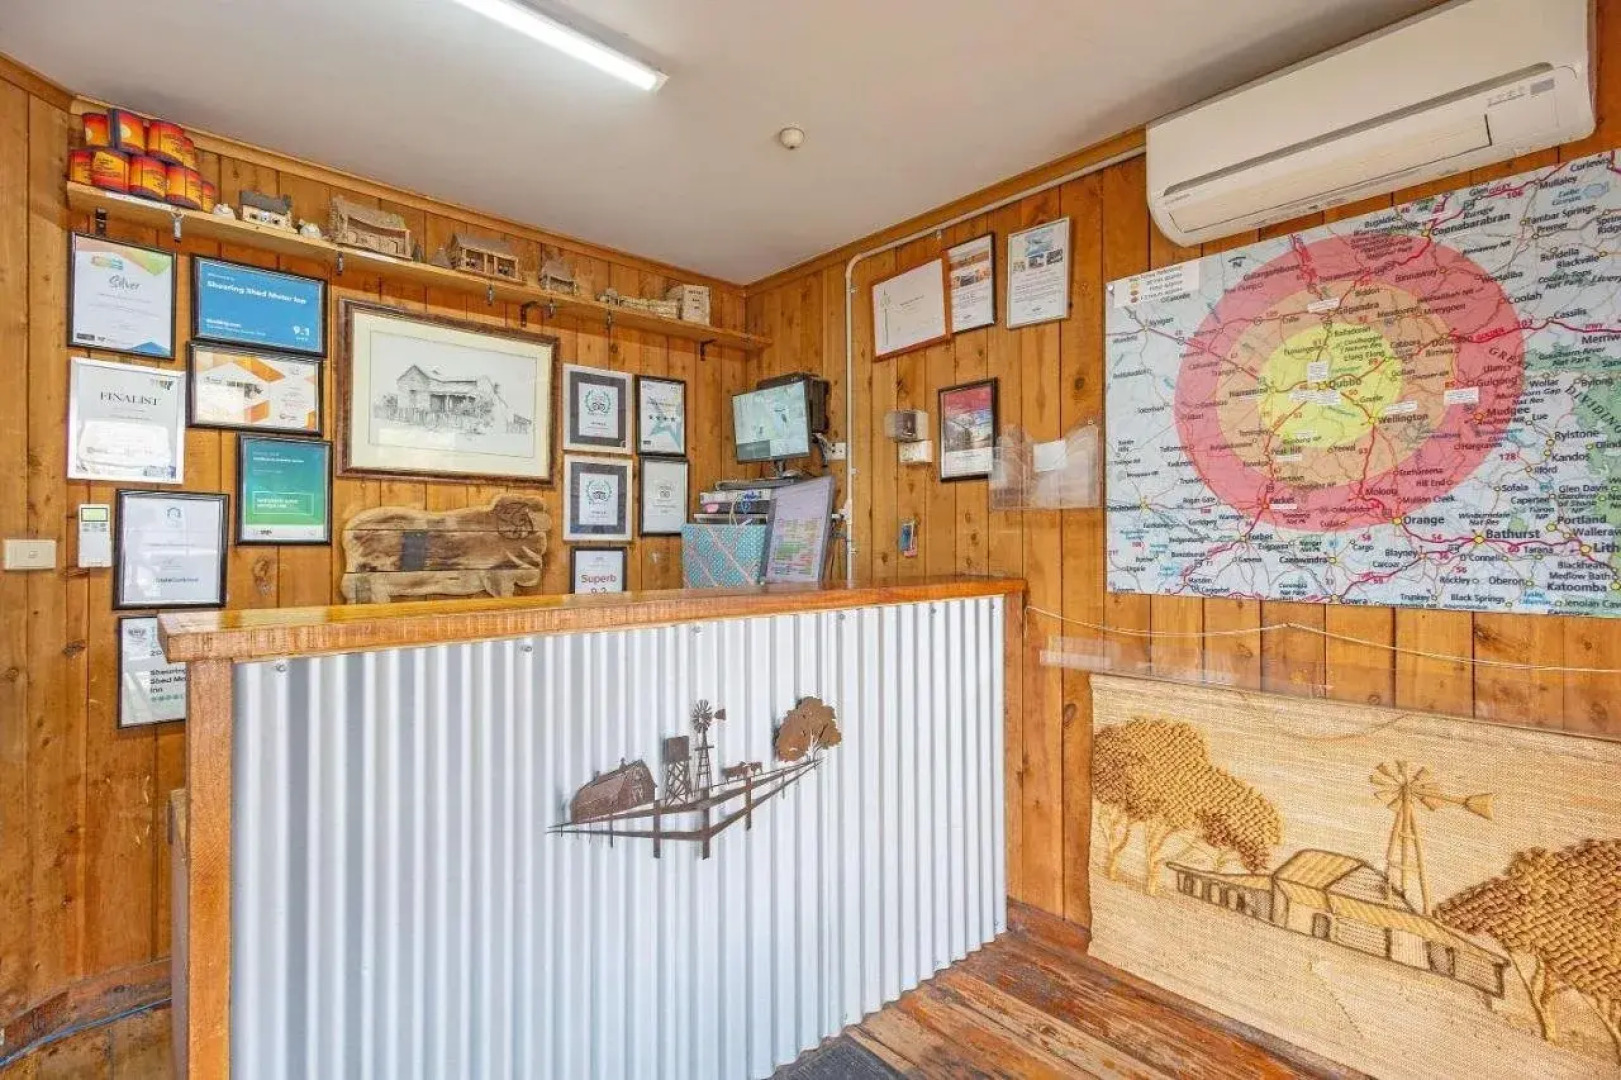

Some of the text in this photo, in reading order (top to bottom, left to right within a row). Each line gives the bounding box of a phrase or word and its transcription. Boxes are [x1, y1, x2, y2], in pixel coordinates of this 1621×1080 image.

[1526, 204, 1596, 225] Tambar Springs
[1432, 212, 1511, 236] Coonabarabran
[1540, 248, 1579, 261] Bundella
[1556, 255, 1599, 268] Blackville
[109, 275, 140, 290] Silver
[207, 281, 244, 295] Shearing
[246, 288, 267, 297] Shed
[268, 292, 292, 302] Motor
[1507, 292, 1542, 304] Coolah
[1476, 377, 1518, 389] Gulgong
[1529, 379, 1559, 388] Wollar
[1581, 377, 1614, 388] Bylong
[100, 391, 161, 406] FINALIST
[1486, 406, 1530, 417] Mudgee
[1378, 413, 1429, 425] Wellington
[1531, 413, 1549, 421] Lue
[1555, 431, 1600, 442] Rylstone
[1552, 452, 1591, 462] Kandos
[1534, 466, 1558, 475] Ilford
[1501, 484, 1529, 492] Sofala
[1559, 484, 1608, 493] Glen Davis
[1403, 516, 1445, 527] Orange
[1557, 514, 1607, 524] Portland
[1486, 528, 1540, 539] Bathurst
[1354, 543, 1374, 553] Cargo
[1385, 549, 1418, 558] Blayney
[1279, 555, 1328, 564] Canowindra
[1557, 561, 1609, 569] Blackheath
[581, 574, 617, 585] Superb
[1549, 571, 1586, 579] Medlow
[1489, 576, 1525, 585] Oberon
[1547, 582, 1607, 592] Katoomba
[1474, 594, 1505, 604] Springs
[1564, 599, 1599, 608] Jenolan
[150, 677, 172, 685] Shed
